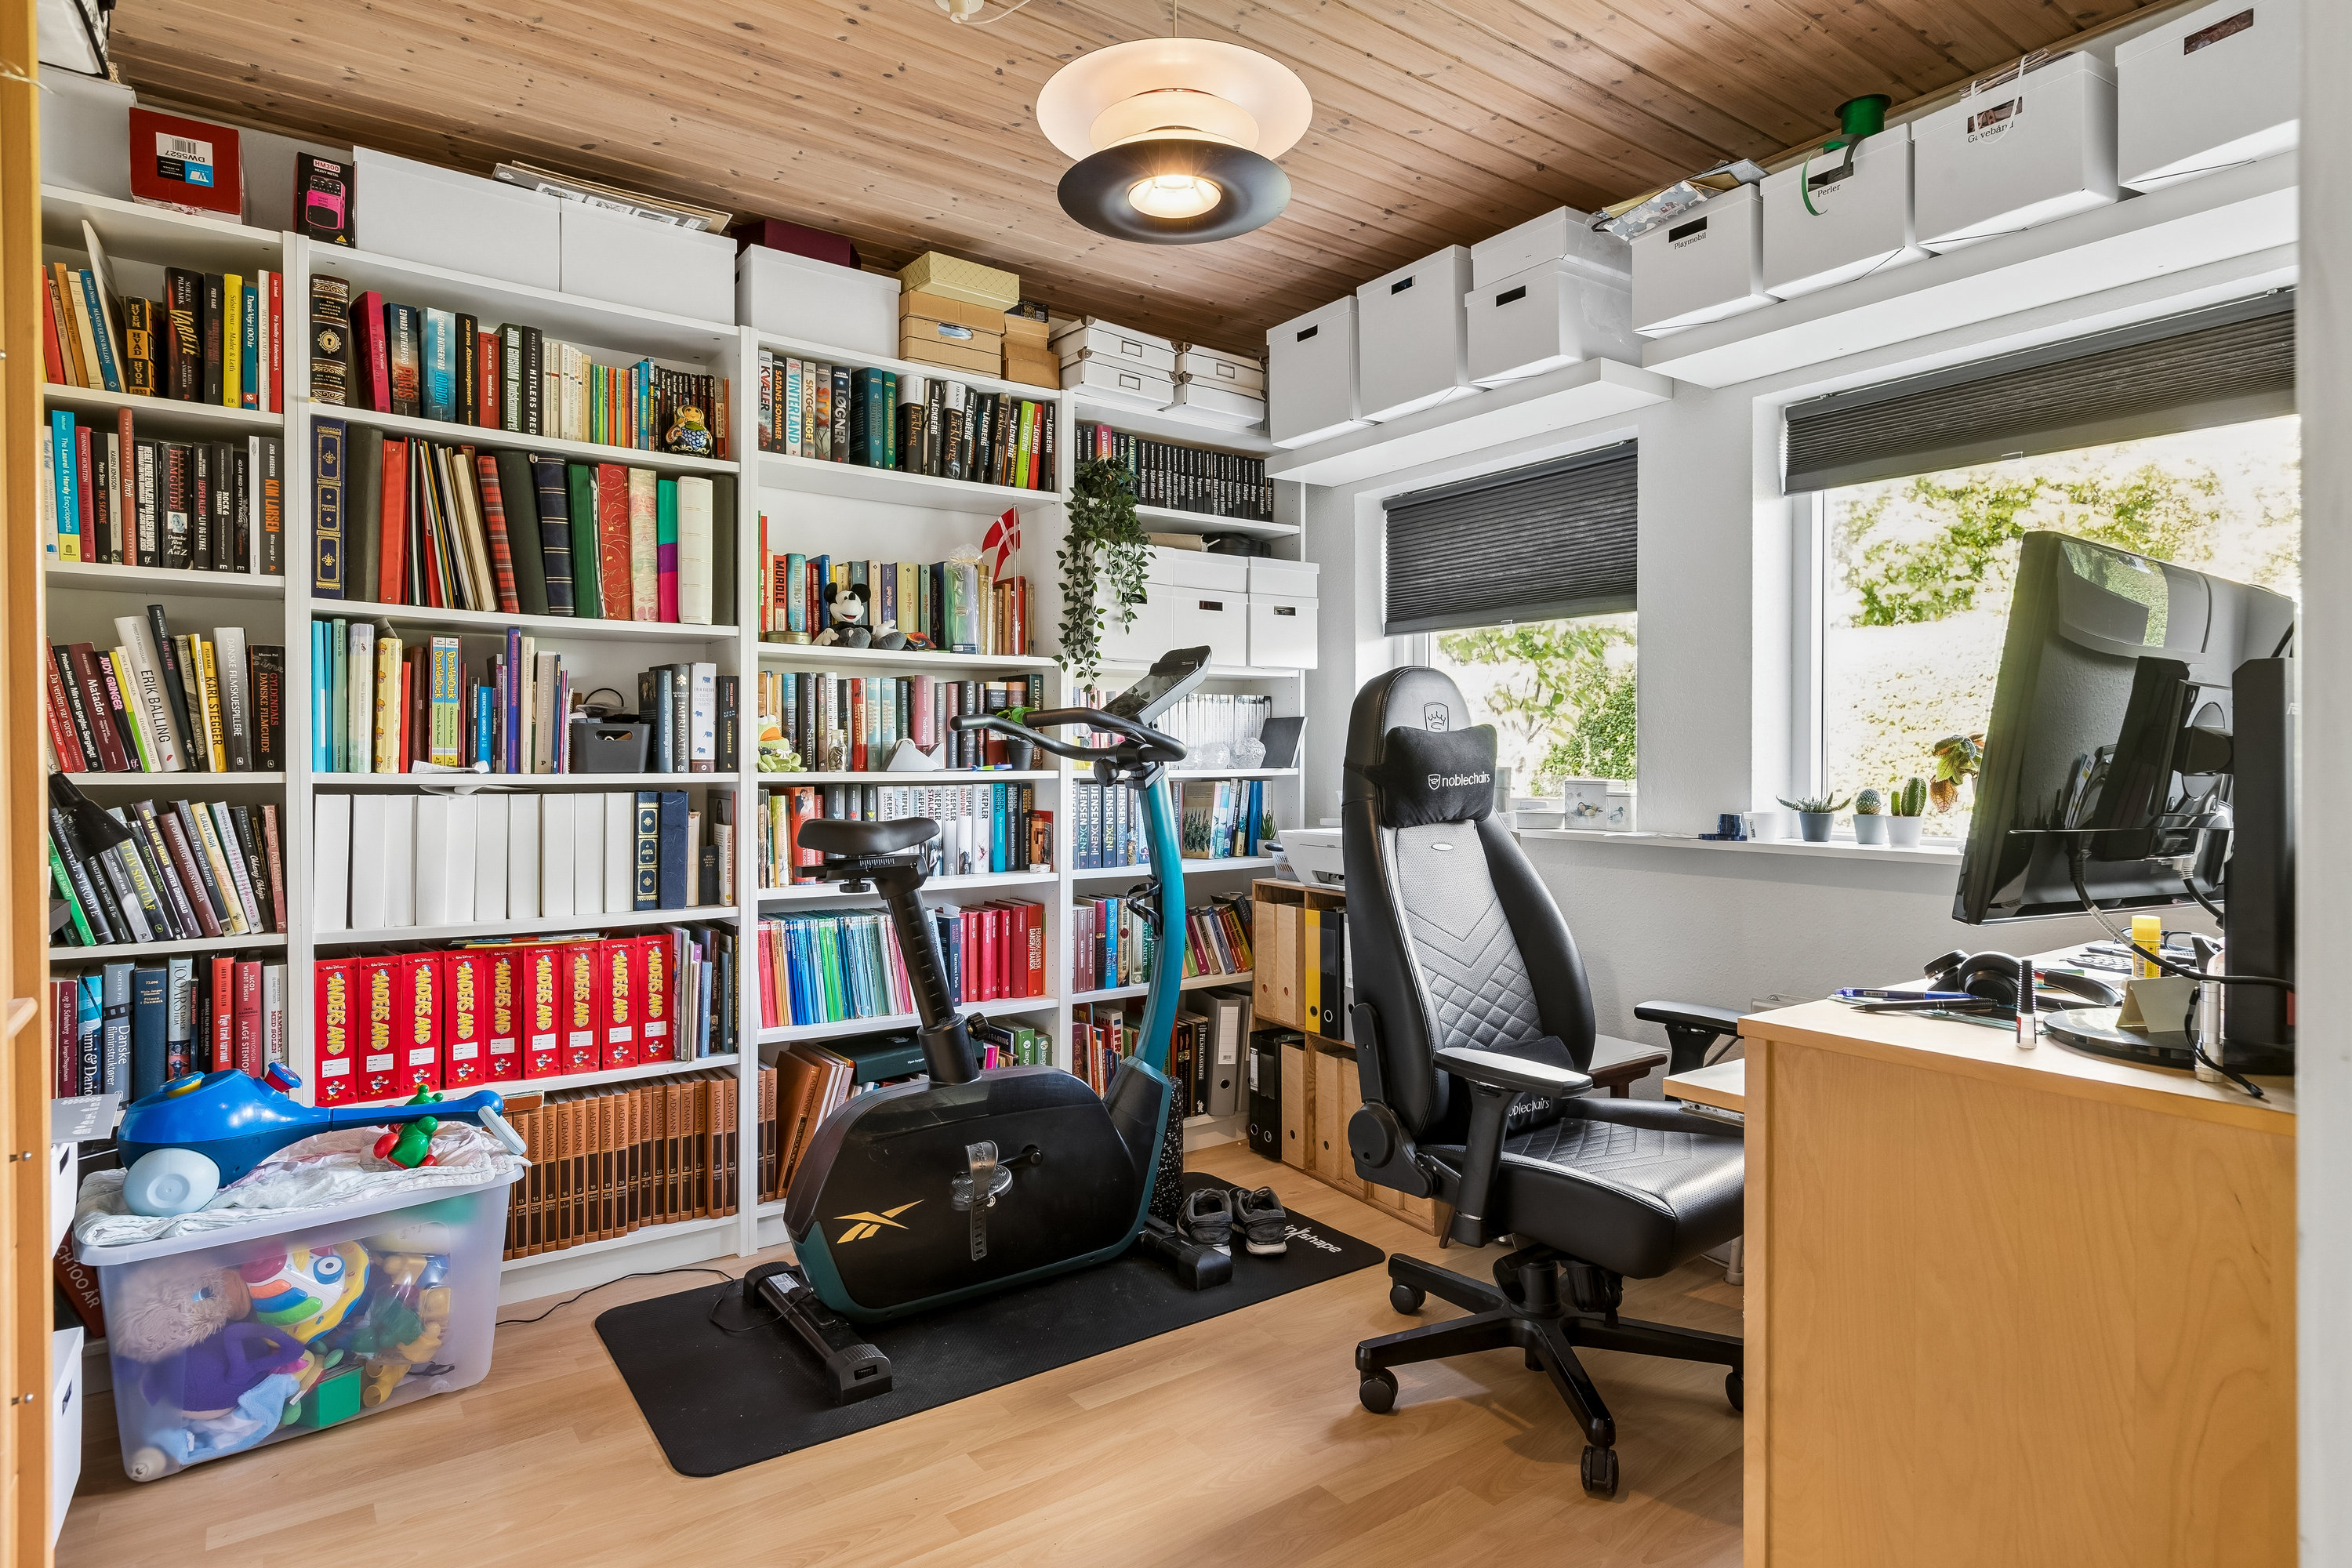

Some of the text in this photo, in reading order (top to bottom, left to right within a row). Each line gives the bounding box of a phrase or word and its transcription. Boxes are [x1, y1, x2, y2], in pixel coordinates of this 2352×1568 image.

[165, 150, 205, 162] DW5527
[314, 161, 339, 171] HM300
[1817, 183, 1841, 198] Perler
[1674, 232, 1707, 250] Playmobil
[131, 304, 140, 327] HVEM
[400, 332, 408, 364] RUTHERFURD
[507, 328, 519, 379] JOHN GRISHAM
[134, 361, 143, 384] HVOR
[397, 366, 414, 399] PARIS
[435, 372, 448, 405] LONDON
[788, 374, 800, 444] VINTERLAND
[805, 379, 814, 444] SKYGGERIGET
[816, 387, 830, 428] STYX
[834, 389, 846, 444] LØGNER
[909, 406, 921, 447] Läckberg
[931, 399, 939, 435] LÄCKBERG
[964, 405, 975, 441] LÄCKBERG
[946, 410, 963, 461] Läckberg
[981, 412, 989, 446] LÄCKBERG
[1007, 419, 1017, 458] LÄCKBERG
[125, 478, 133, 498] Dirch
[169, 449, 178, 509] FILMGUIDE
[63, 495, 71, 532] Encyclopedia
[265, 479, 280, 532] KIM LARSEN
[775, 561, 784, 603] MURDLE
[50, 674, 58, 684] Da
[60, 653, 74, 686] Preben Harris
[100, 656, 123, 710] JUDY GRINGER
[226, 638, 242, 736] DANSKE FILMSKUESPILLERE
[447, 651, 457, 699] Donald Duck
[53, 686, 64, 707] verden
[87, 679, 104, 716] Matador
[141, 670, 154, 694] ERIK
[148, 699, 171, 743] BALLING
[206, 677, 223, 745] KARL STEGGER
[270, 673, 278, 725] GYLDENDALS
[63, 720, 73, 738] vores
[260, 707, 269, 753] FILMGUIDE
[1442, 771, 1490, 787] noblechairs
[199, 813, 216, 848] KLAUS PAGH
[75, 873, 100, 917] STRØBYE
[165, 867, 188, 914] MORTEN GRUNWALD
[327, 976, 346, 1025] ANDERS
[371, 974, 390, 1022] ANDERS
[457, 965, 474, 1040] ANDERS AND
[495, 962, 511, 1035] ANDERS AND
[536, 959, 553, 1031] ANDERS AND
[573, 956, 590, 1028] ANDERS AND
[612, 954, 629, 1024] ANDERS AND
[648, 950, 663, 1018] ANDERS AND
[414, 969, 432, 1045] ANDERS AND
[107, 1026, 118, 1086] filminstruktører
[118, 1025, 130, 1065] Danske
[327, 1025, 346, 1055] AND
[371, 1022, 389, 1051] AND
[992, 1034, 1009, 1045] E-LÆRING
[84, 1020, 97, 1096] Daimi & Dario
[803, 1076, 818, 1112] LADEMANN
[1298, 1233, 1342, 1252] shape
[66, 1264, 102, 1309] 100 ÅR
